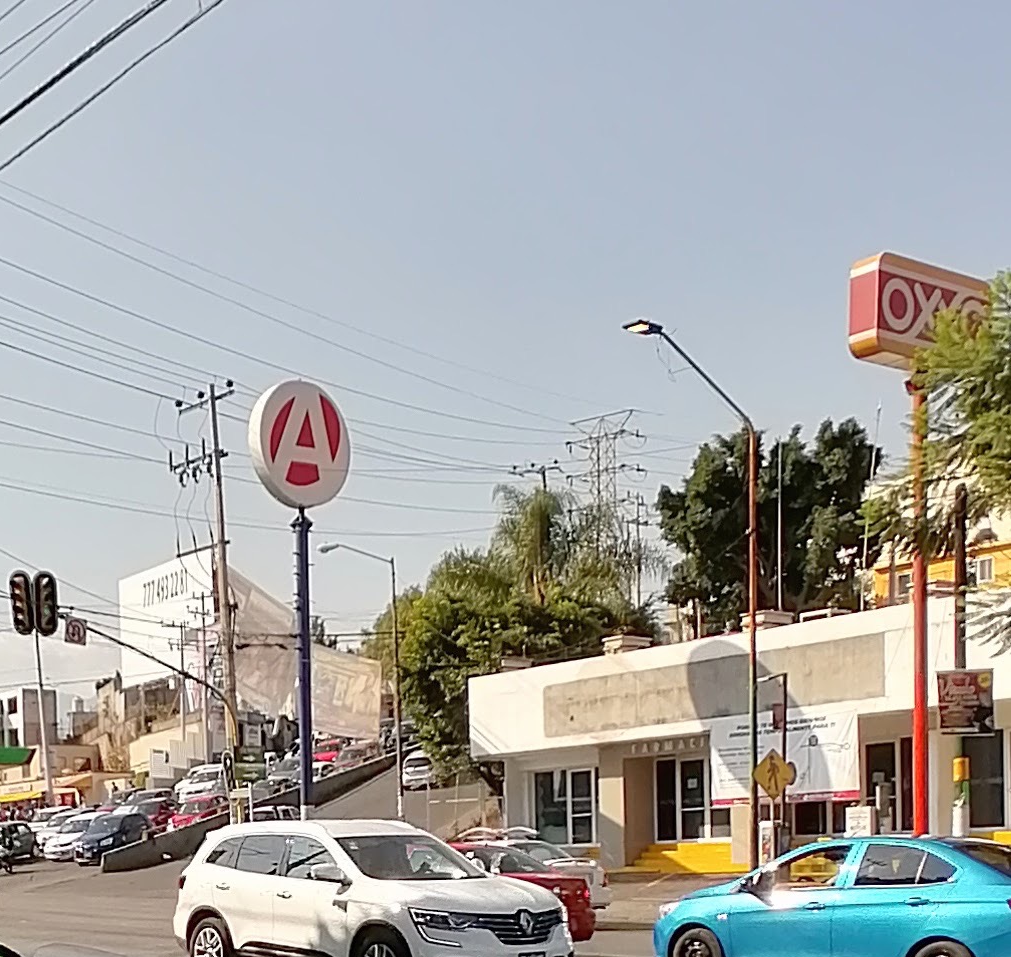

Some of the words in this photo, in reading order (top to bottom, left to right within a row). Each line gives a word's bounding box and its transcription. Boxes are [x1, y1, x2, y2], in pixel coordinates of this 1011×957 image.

[142, 579, 155, 608] 777
[156, 574, 169, 603] 493
[170, 571, 179, 598] 22
